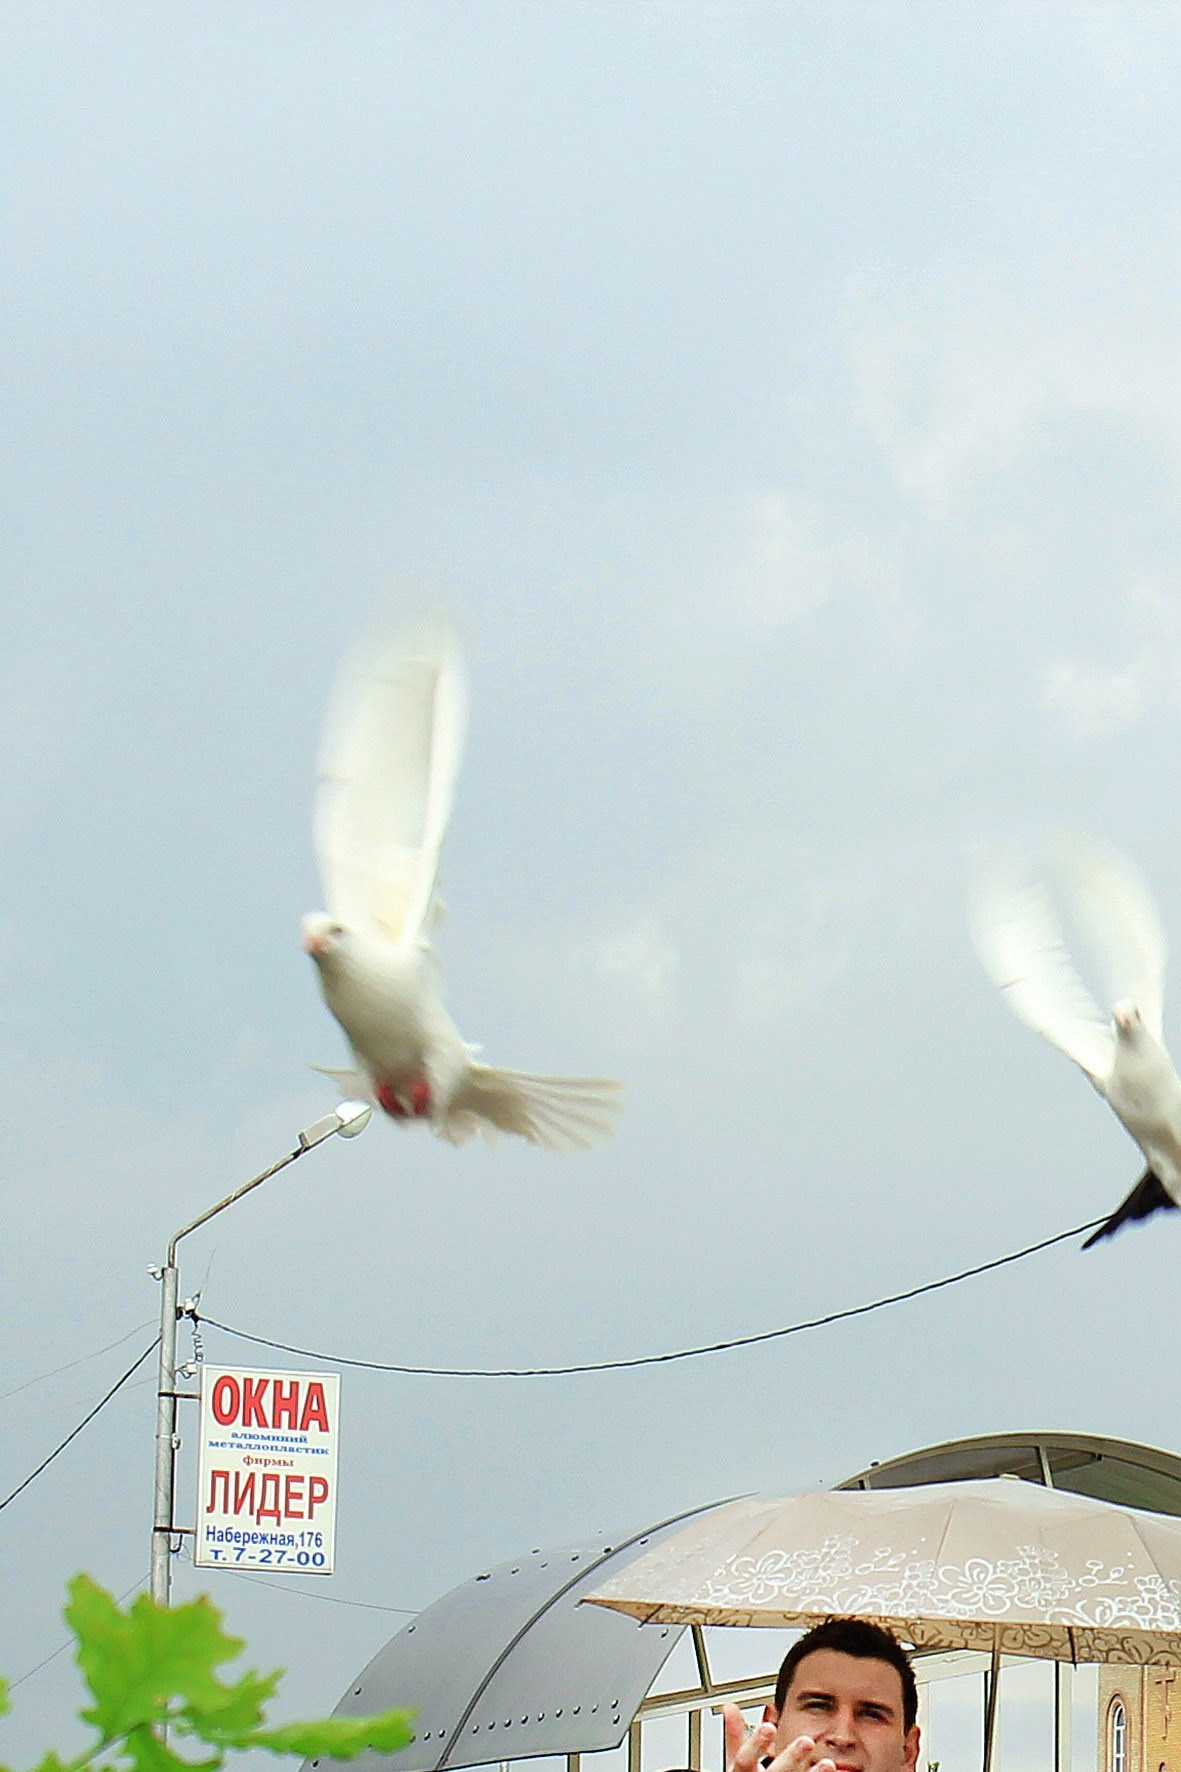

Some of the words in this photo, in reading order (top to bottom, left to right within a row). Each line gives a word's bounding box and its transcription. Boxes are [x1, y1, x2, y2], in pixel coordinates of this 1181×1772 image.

[212, 1375, 330, 1433] ОКНА
[208, 1440, 329, 1455] металлопластик
[230, 1431, 309, 1444] алюминий
[242, 1455, 295, 1467] фирмы
[206, 1470, 329, 1527] ЛИДЕР
[206, 1525, 323, 1548] Набережная,176
[210, 1548, 227, 1562] т.
[233, 1547, 326, 1567] 7-27-00
